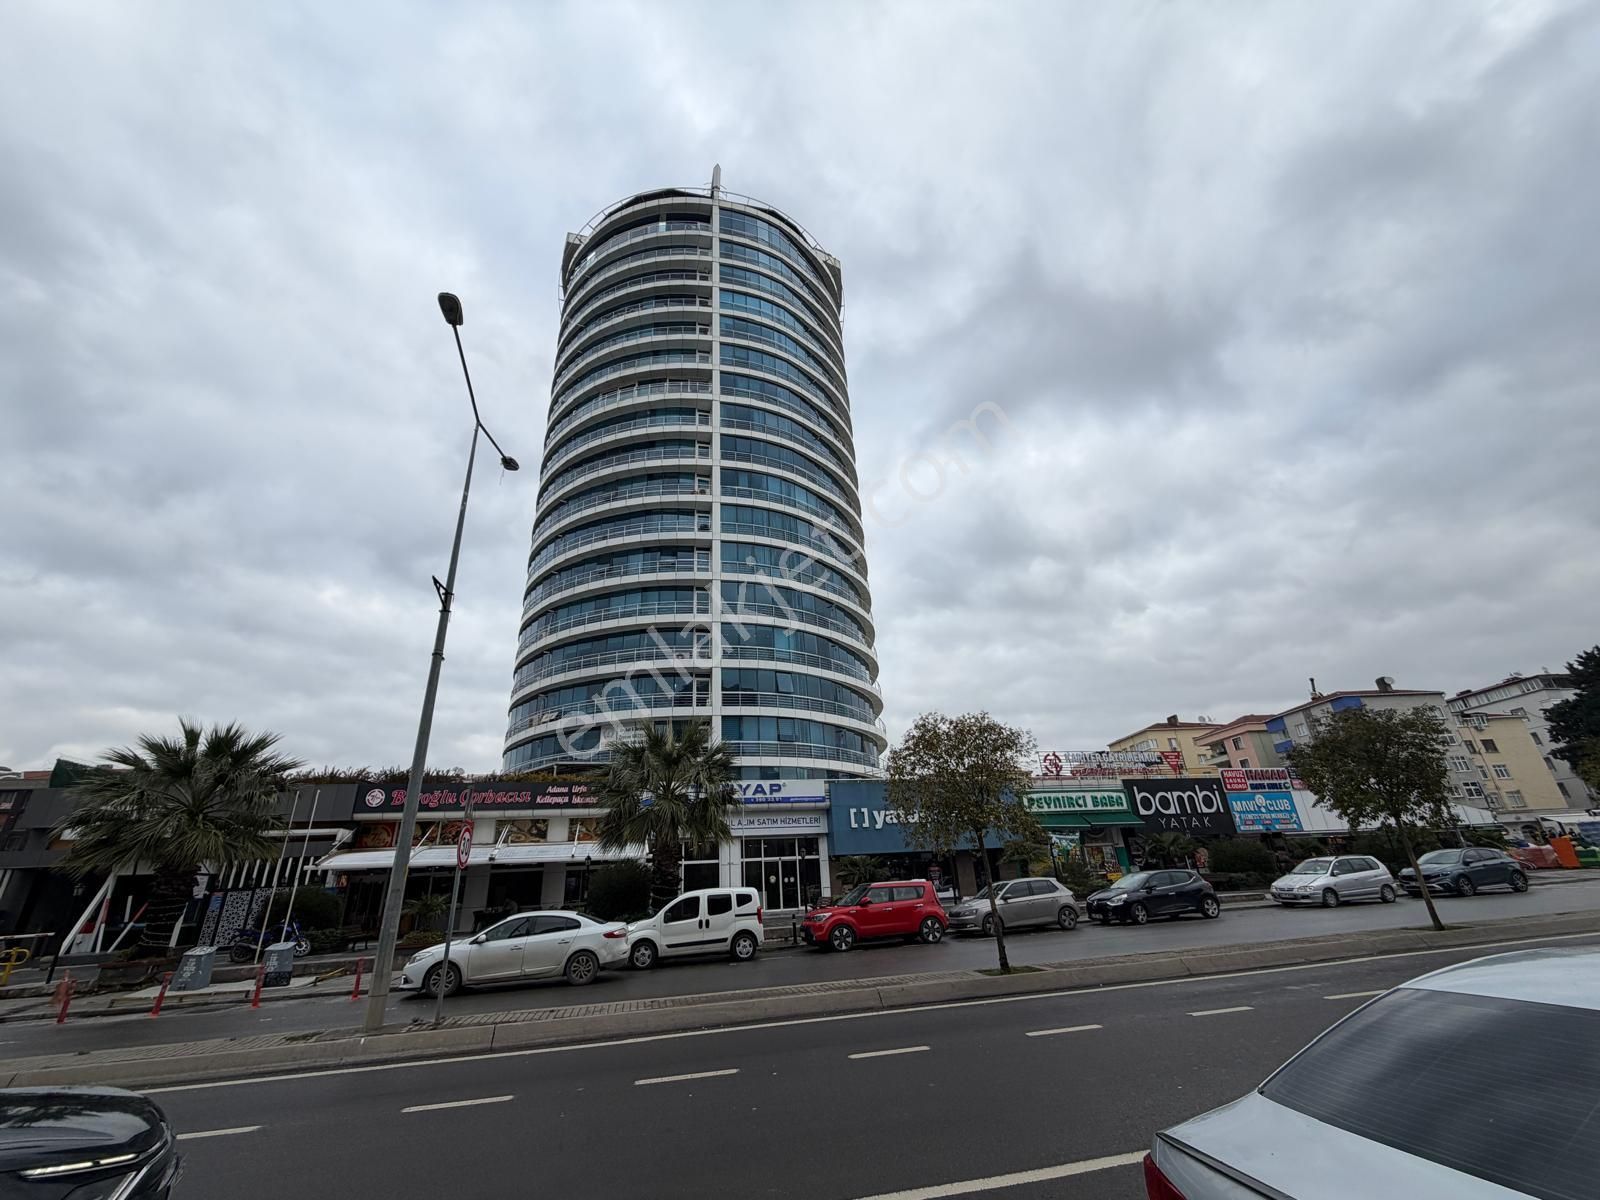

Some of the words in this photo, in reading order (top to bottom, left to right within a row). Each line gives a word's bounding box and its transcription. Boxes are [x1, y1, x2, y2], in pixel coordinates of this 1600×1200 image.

[1247, 769, 1288, 781] HAMAM
[546, 785, 569, 794] Adana
[572, 784, 588, 794] Urfa
[391, 790, 457, 808] Boğlu
[1091, 794, 1125, 808] BABA
[1133, 784, 1225, 815] bambi
[1266, 799, 1292, 811] CLUB
[757, 818, 779, 827] SATIM
[780, 815, 821, 826] HİZMETLERİ
[872, 806, 931, 829] yata
[1158, 816, 1213, 829] YATAK
[461, 836, 470, 856] 30
